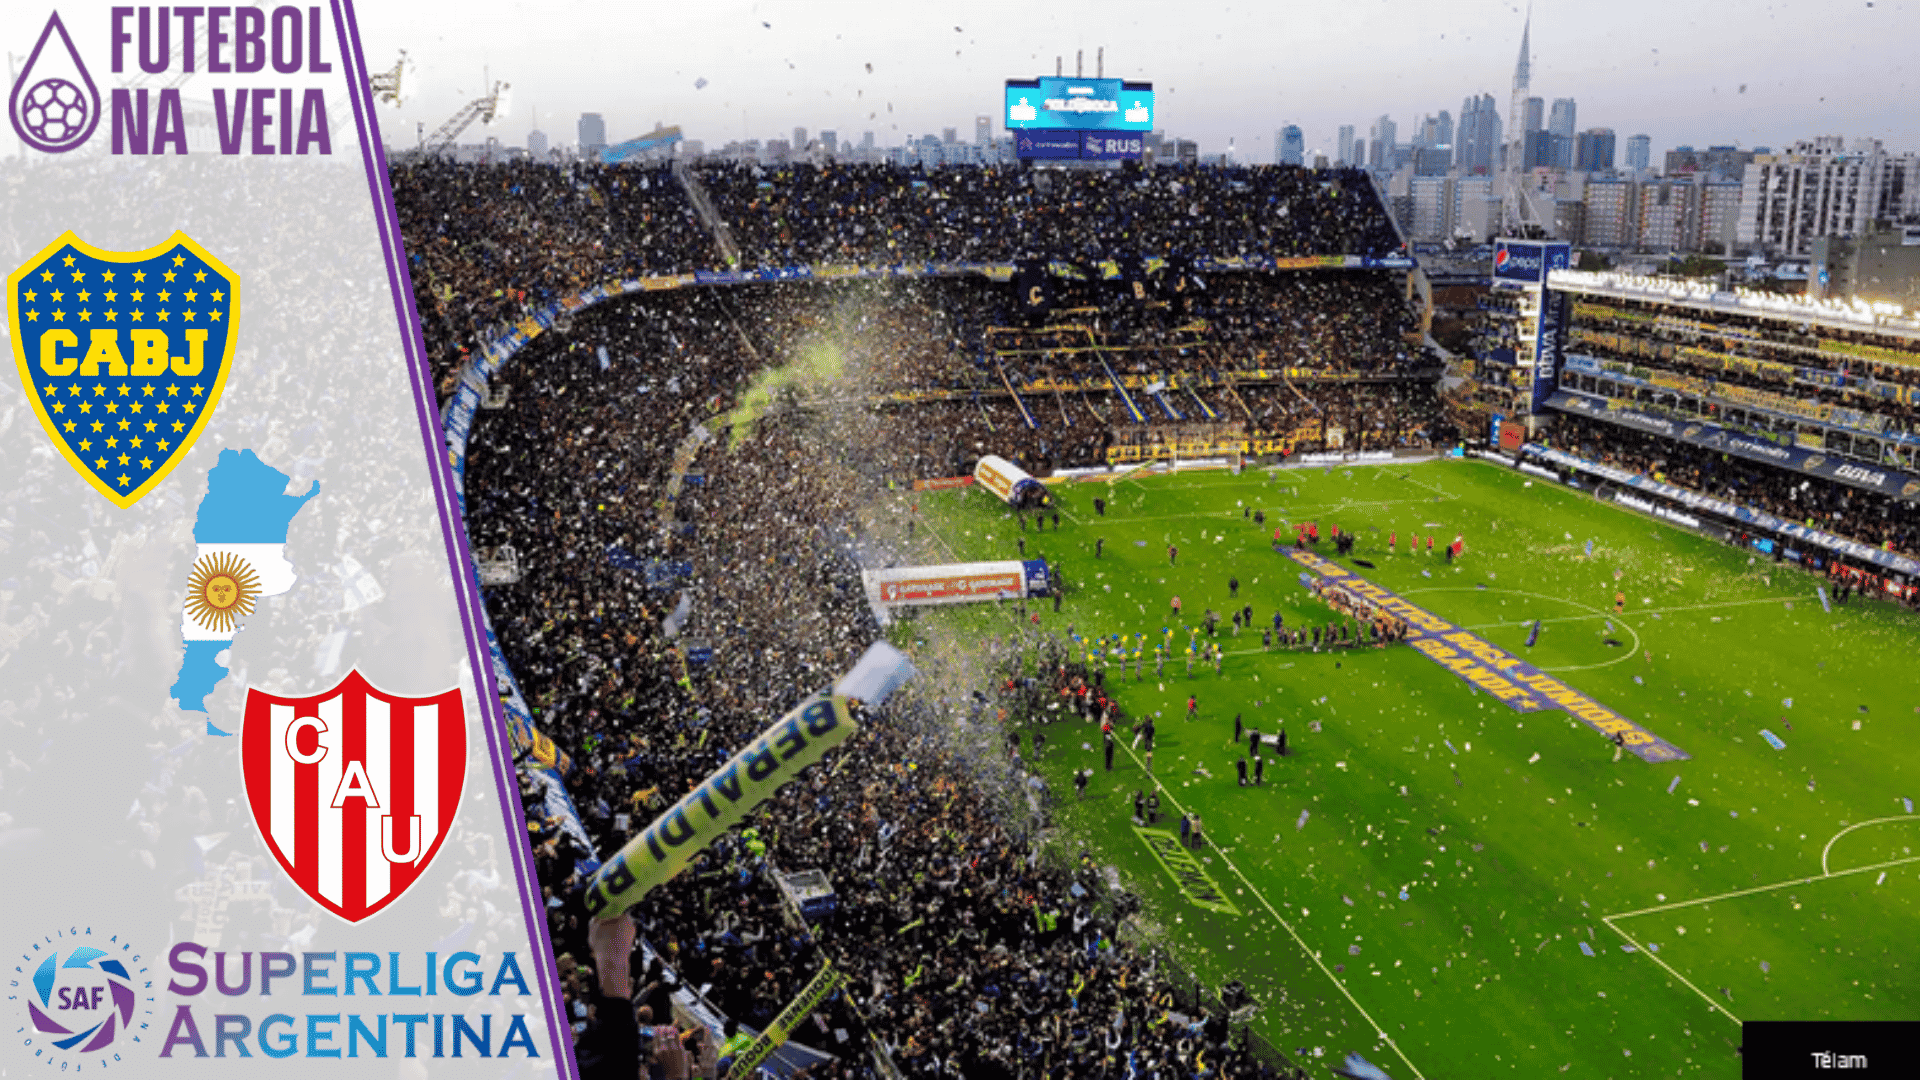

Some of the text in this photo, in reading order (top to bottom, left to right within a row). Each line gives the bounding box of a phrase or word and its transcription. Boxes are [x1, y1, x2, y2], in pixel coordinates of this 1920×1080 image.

[1105, 138, 1142, 153] RUS
[1514, 672, 1656, 746] JUNIORS
[646, 697, 839, 863] BERALDI
